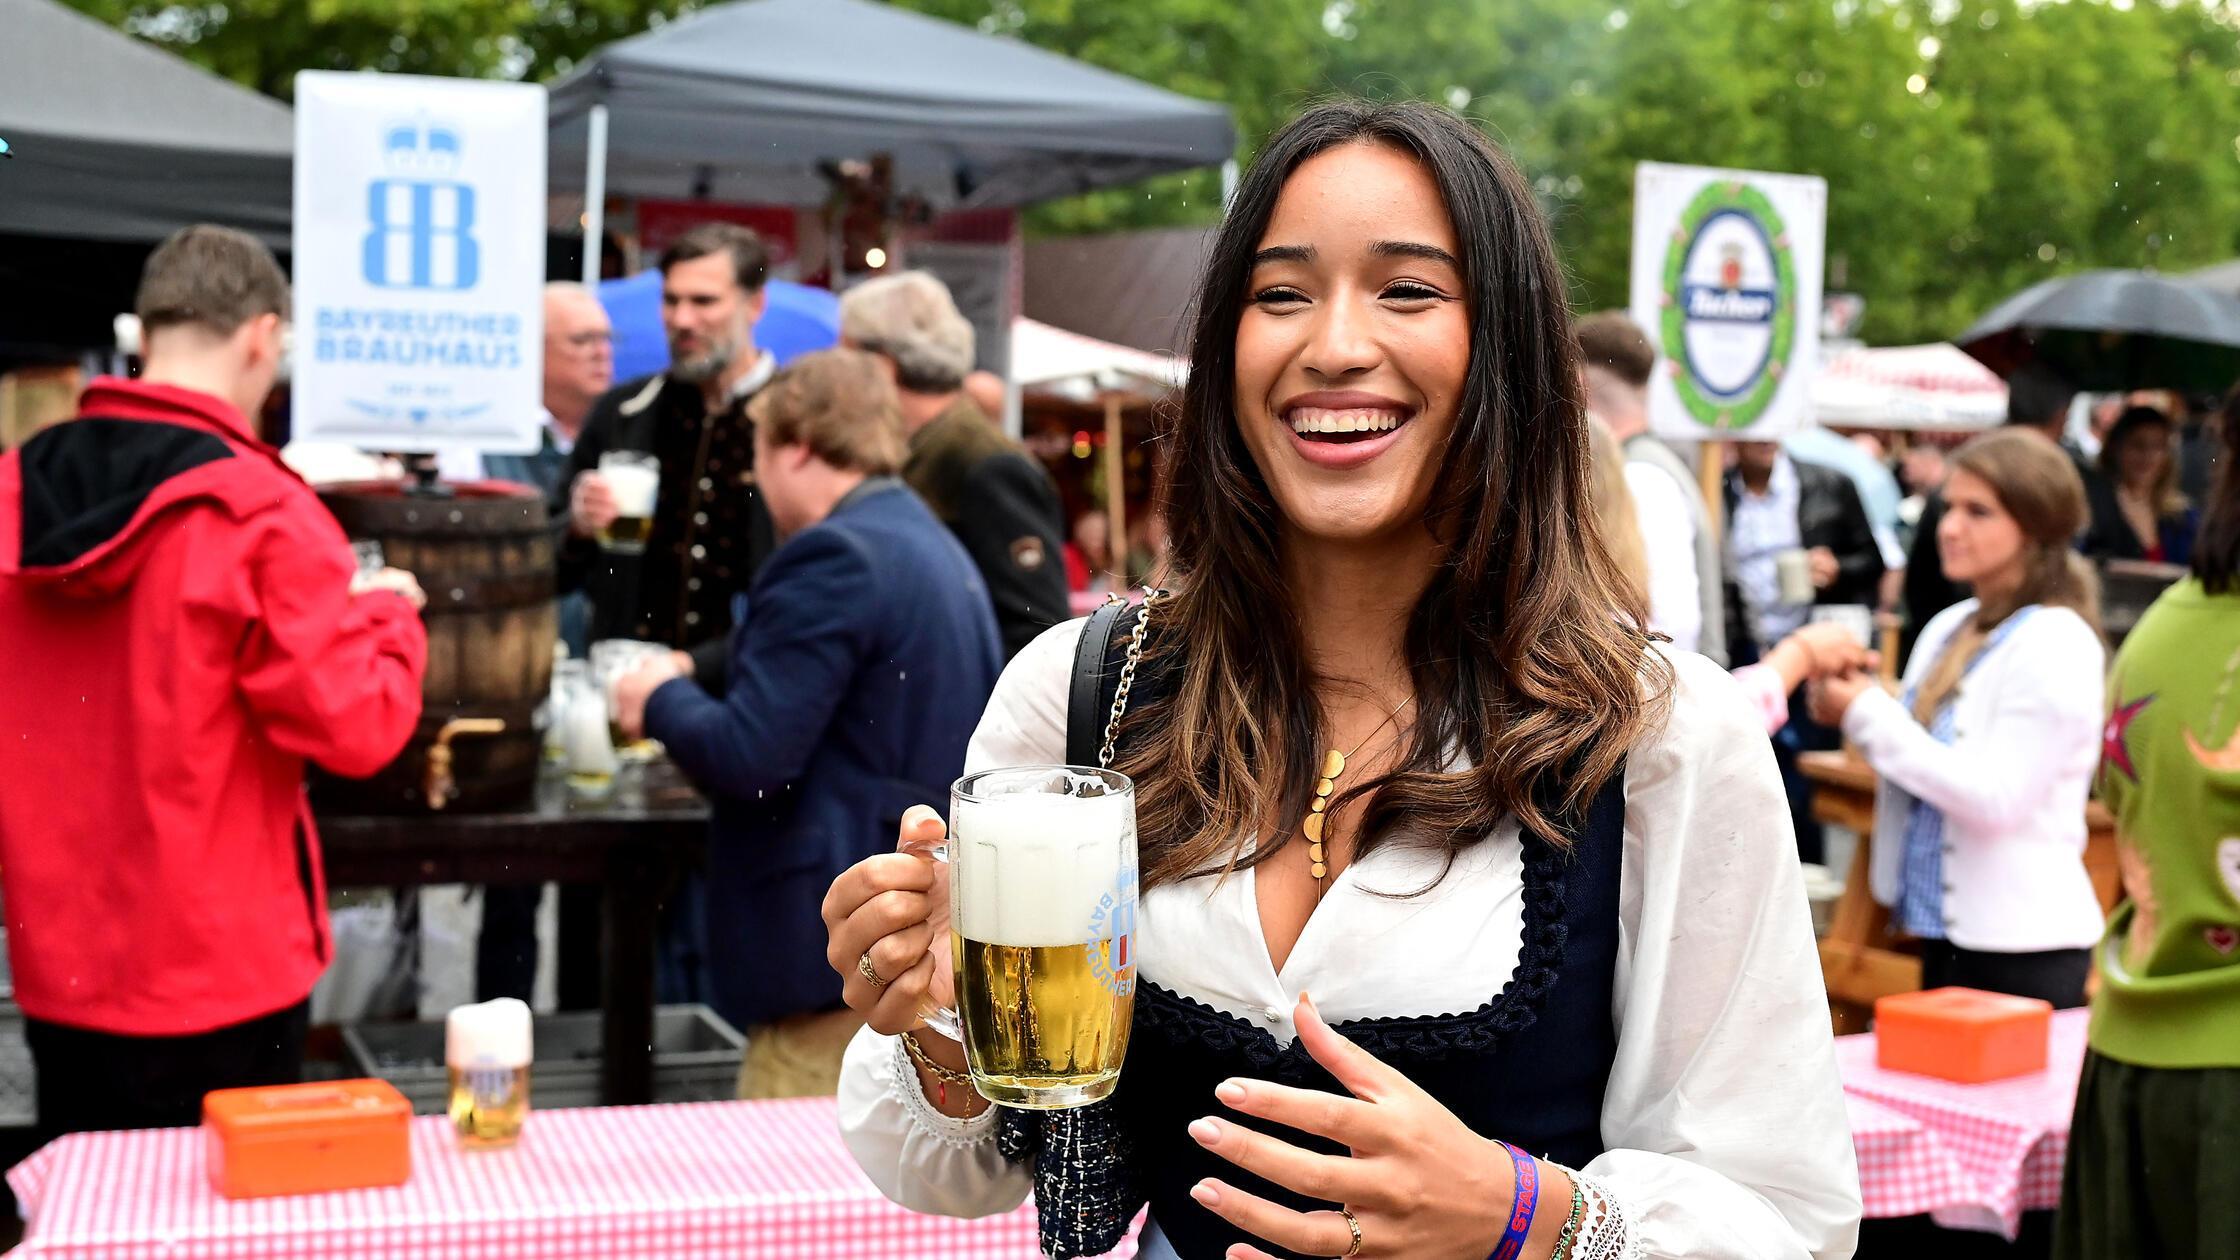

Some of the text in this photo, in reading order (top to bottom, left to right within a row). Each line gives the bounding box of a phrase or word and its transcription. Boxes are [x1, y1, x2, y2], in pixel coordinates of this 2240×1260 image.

[316, 307, 522, 336] BAYREUTHER
[316, 335, 522, 369] BRAUHAUS
[1511, 1160, 1536, 1233] STAGE
